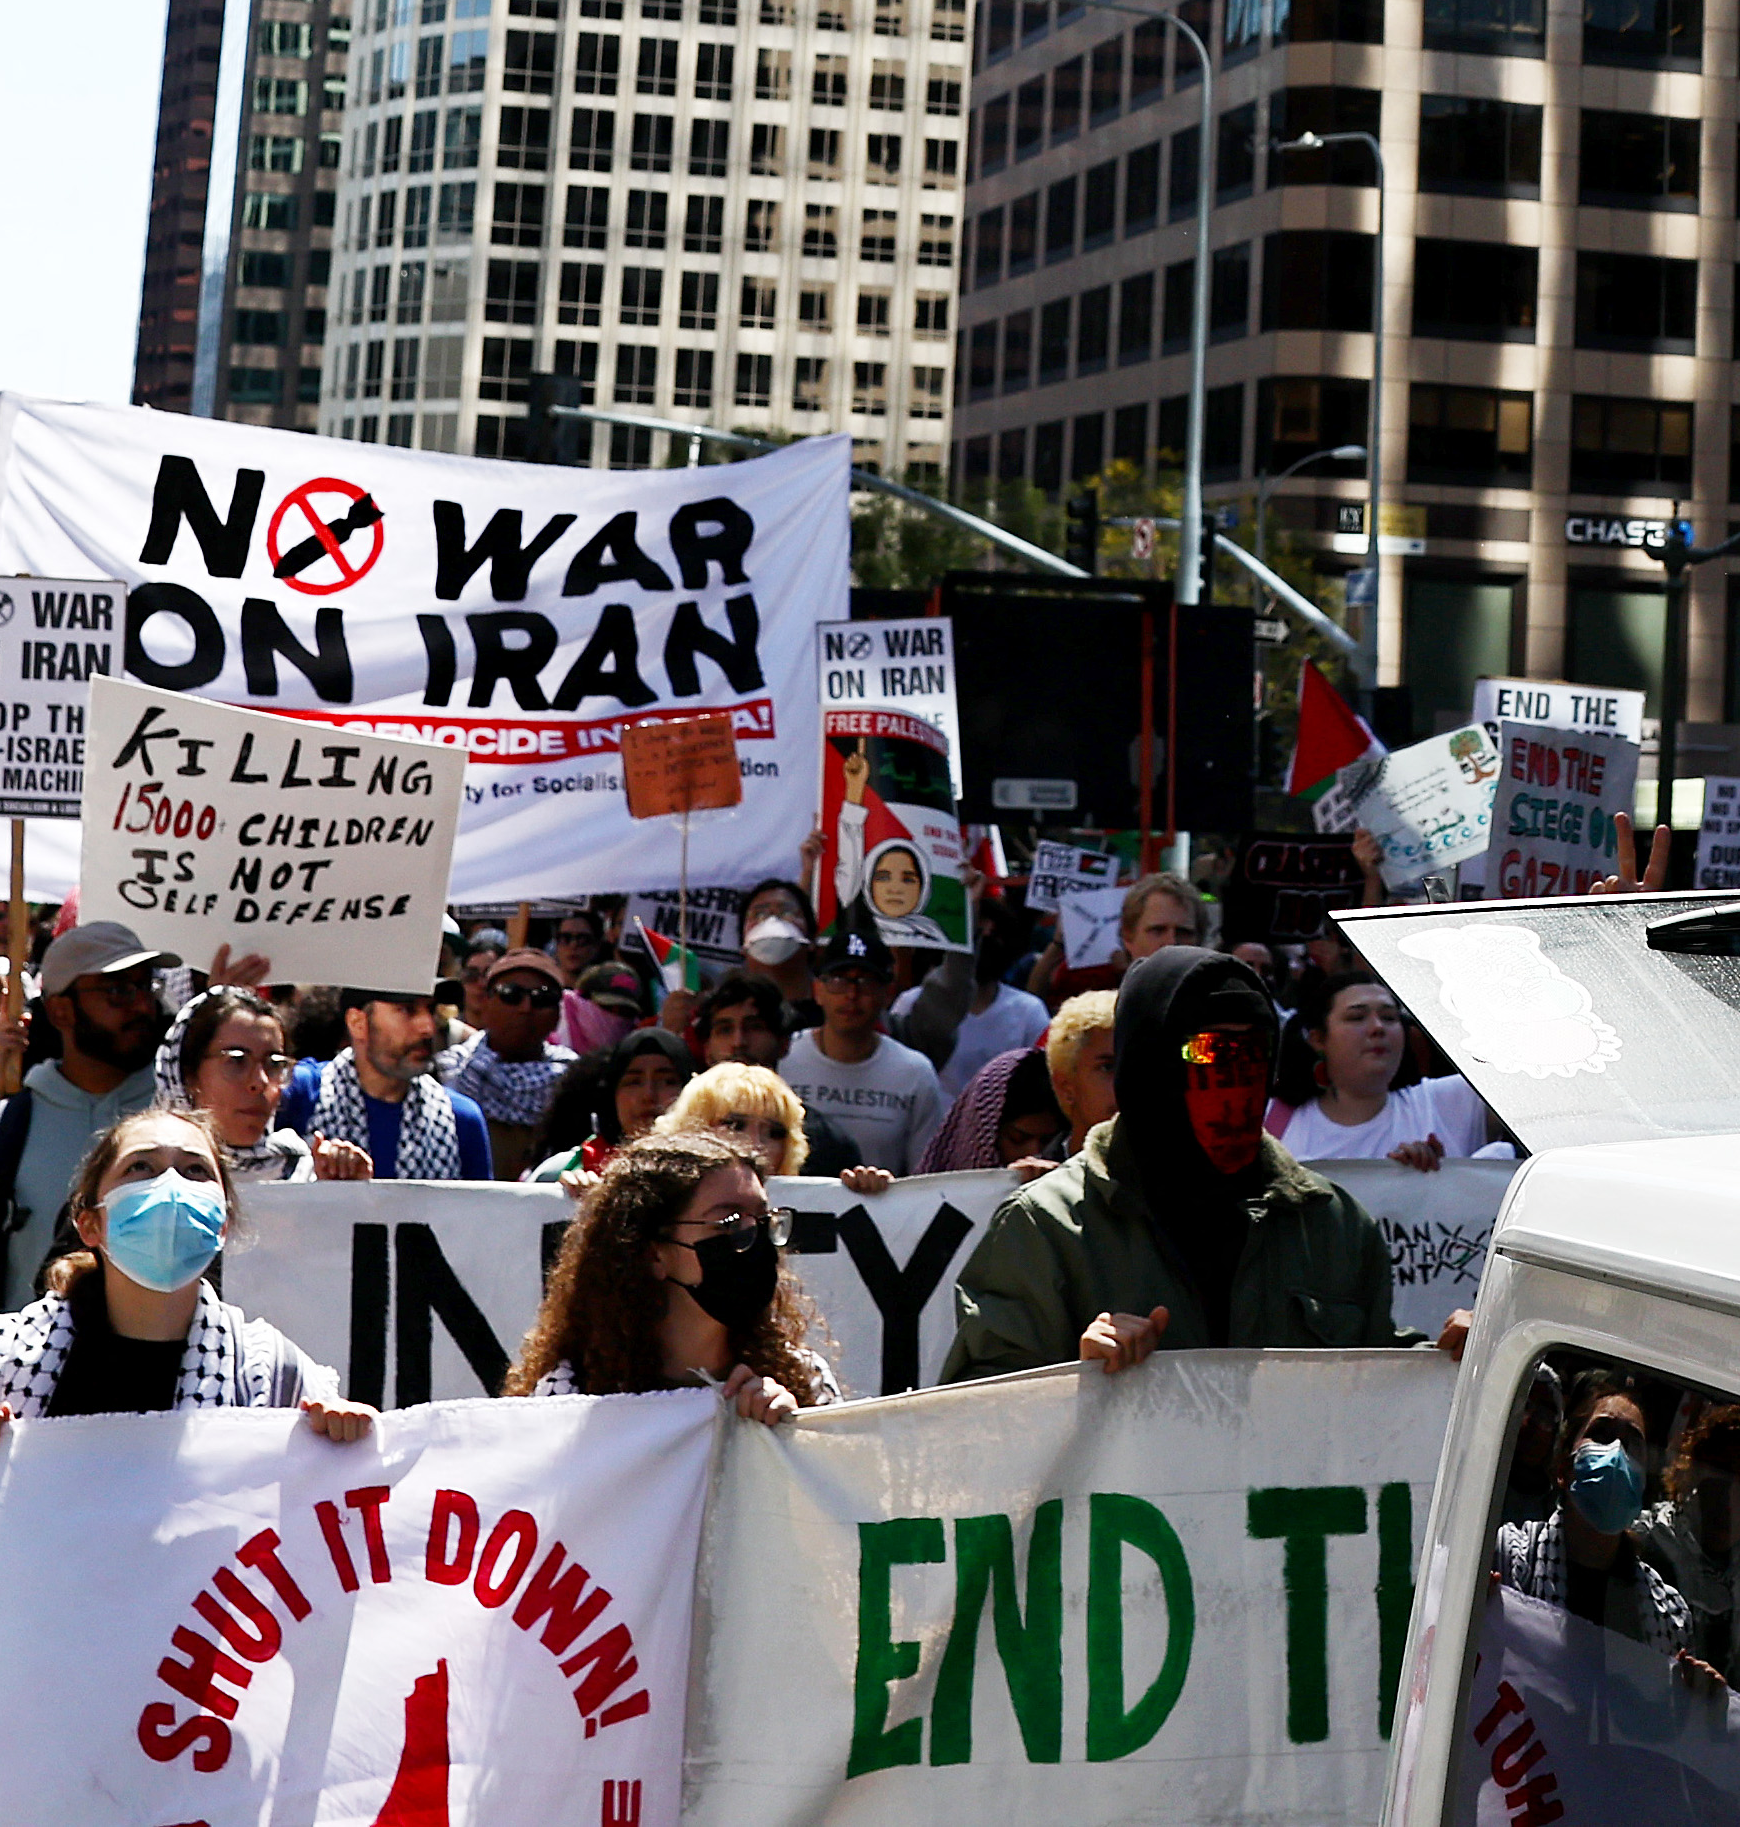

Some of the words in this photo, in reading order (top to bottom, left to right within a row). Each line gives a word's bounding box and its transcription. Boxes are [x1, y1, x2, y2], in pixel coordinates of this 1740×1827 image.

[432, 497, 754, 602] WAR
[1565, 518, 1666, 548] CHASE
[32, 591, 114, 631] WAR
[21, 641, 110, 681] IRAN
[124, 581, 354, 704] ON
[417, 592, 764, 712] IRAN
[883, 627, 944, 658] WAR
[828, 669, 865, 699] ON
[881, 665, 945, 697] IRAN
[47, 704, 84, 734] TH
[826, 714, 873, 734] FREE
[1498, 689, 1551, 720] END
[1570, 695, 1618, 727] THE
[112, 706, 433, 796] KILLING
[1511, 737, 1561, 789] END
[1562, 747, 1607, 798] THE
[3, 768, 83, 793] MACHI
[492, 780, 523, 799] for
[532, 772, 625, 795] Socialis
[238, 813, 435, 849] CHILDREN
[1509, 792, 1586, 846] SIEGE
[131, 848, 196, 885] IS
[229, 856, 333, 895] NOT
[118, 878, 218, 917] SELF
[234, 894, 412, 925] DEFENSE
[137, 1526, 314, 1774] SHUT
[313, 1485, 393, 1594] IT
[424, 1488, 651, 1741] DOWN!
[846, 1492, 1196, 1780] END
